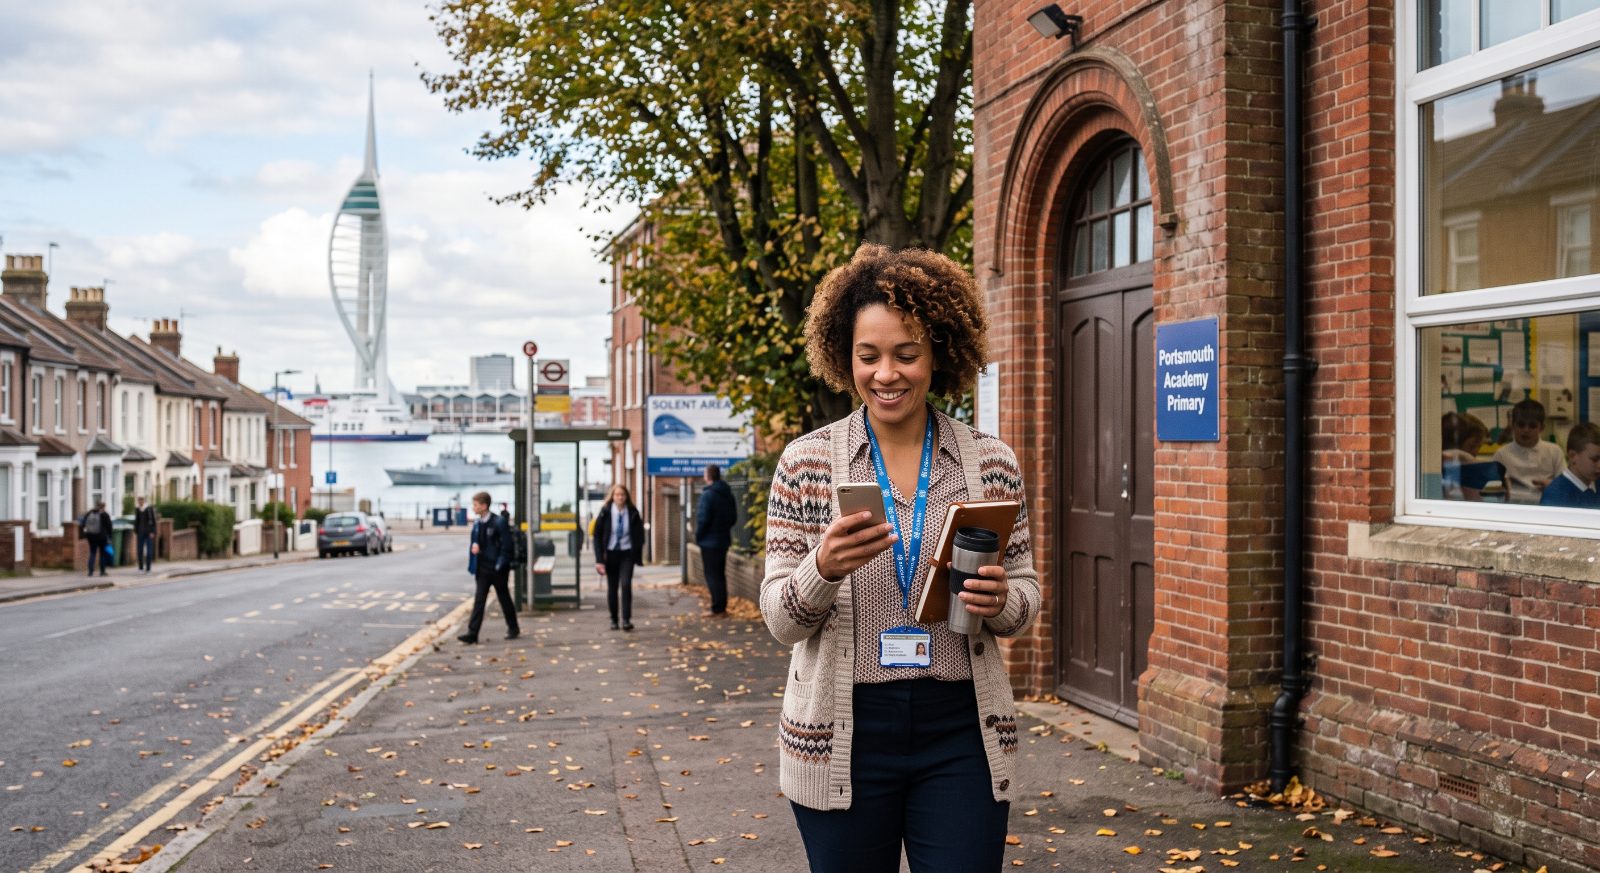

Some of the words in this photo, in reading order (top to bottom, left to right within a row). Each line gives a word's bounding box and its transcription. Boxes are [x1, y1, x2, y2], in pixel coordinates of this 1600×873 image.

[1159, 344, 1214, 366] Portsmouth
[1164, 370, 1209, 391] Academy
[652, 400, 697, 410] SOLENT
[700, 400, 732, 410] AREA
[1167, 394, 1205, 415] Primary
